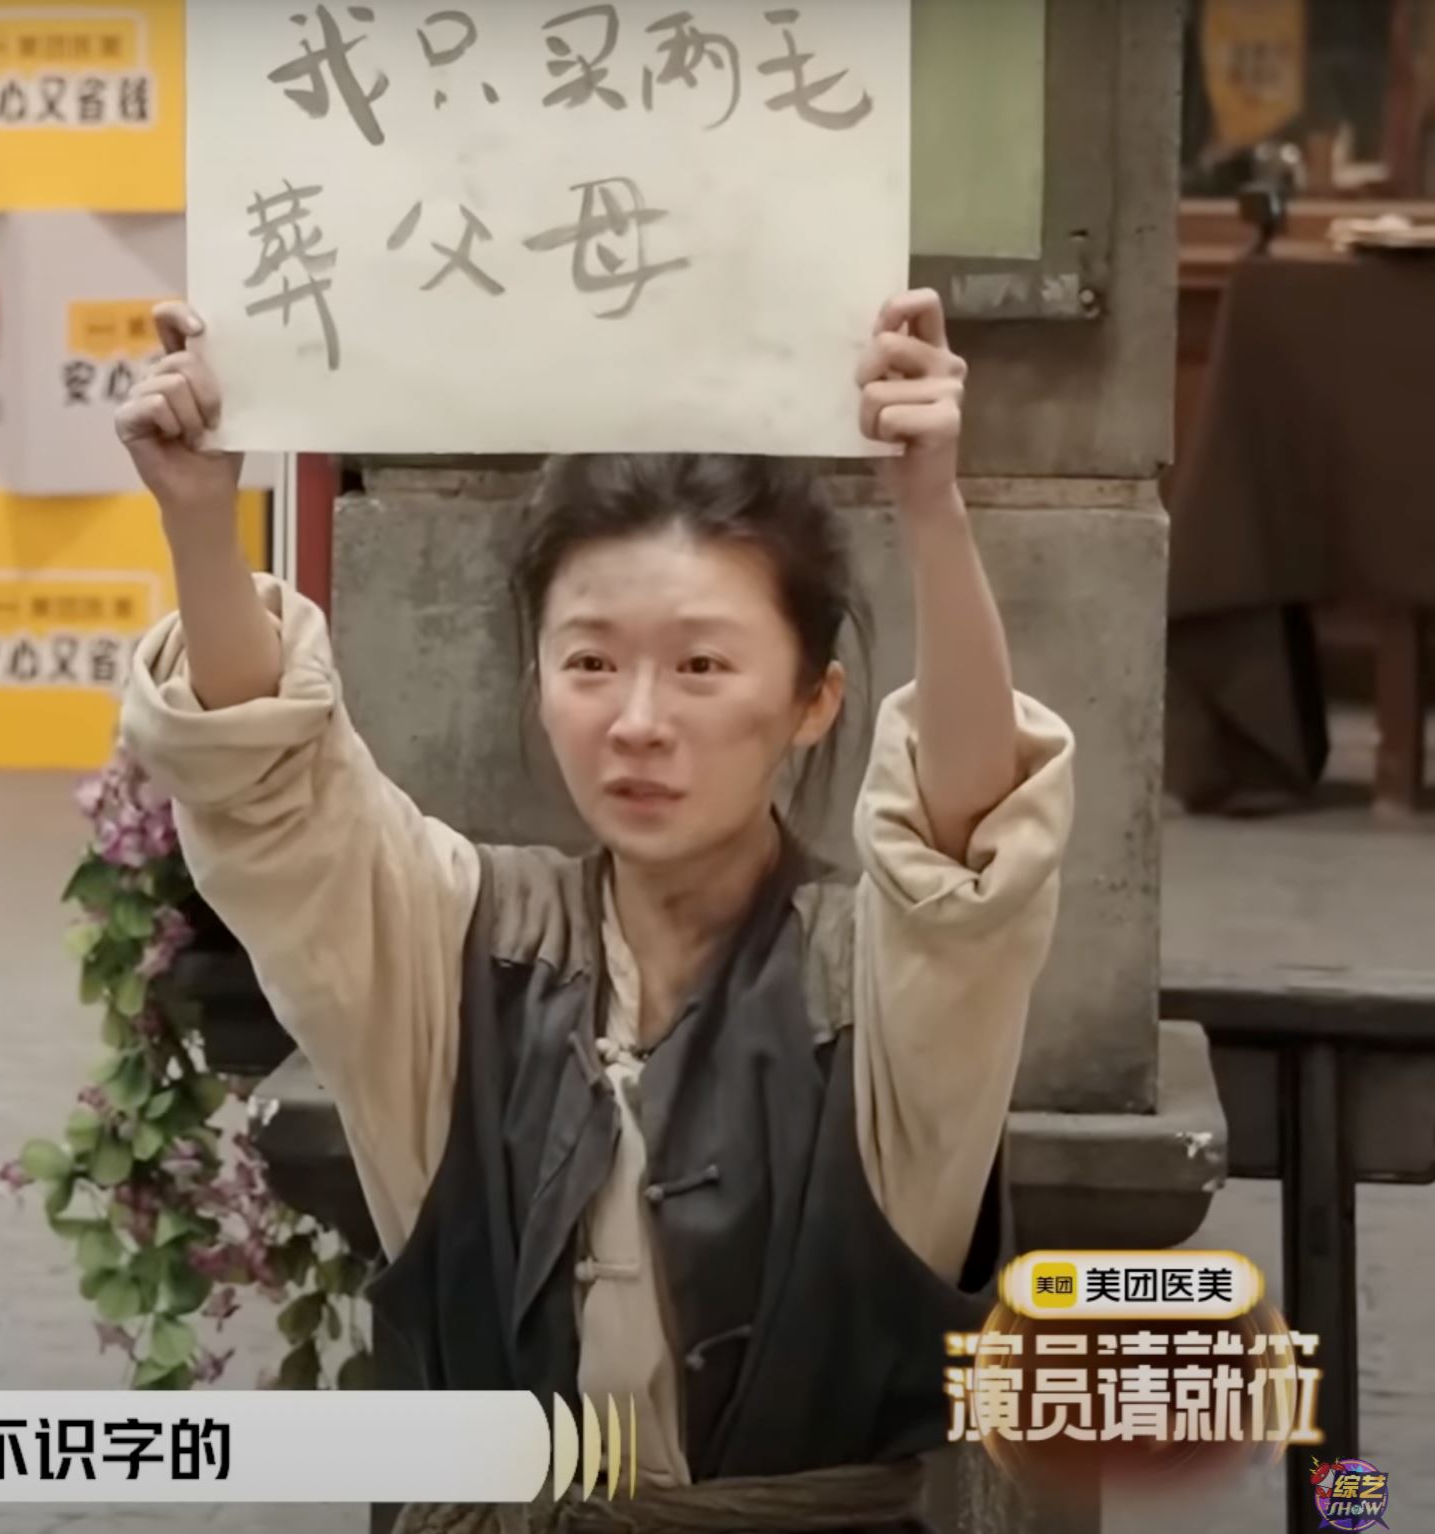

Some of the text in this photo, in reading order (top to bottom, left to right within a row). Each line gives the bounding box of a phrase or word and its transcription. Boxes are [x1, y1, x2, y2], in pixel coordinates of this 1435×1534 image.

[267, 3, 873, 146] 我只买两毛
[245, 177, 692, 372] 葬父母
[63, 354, 157, 406] 安心
